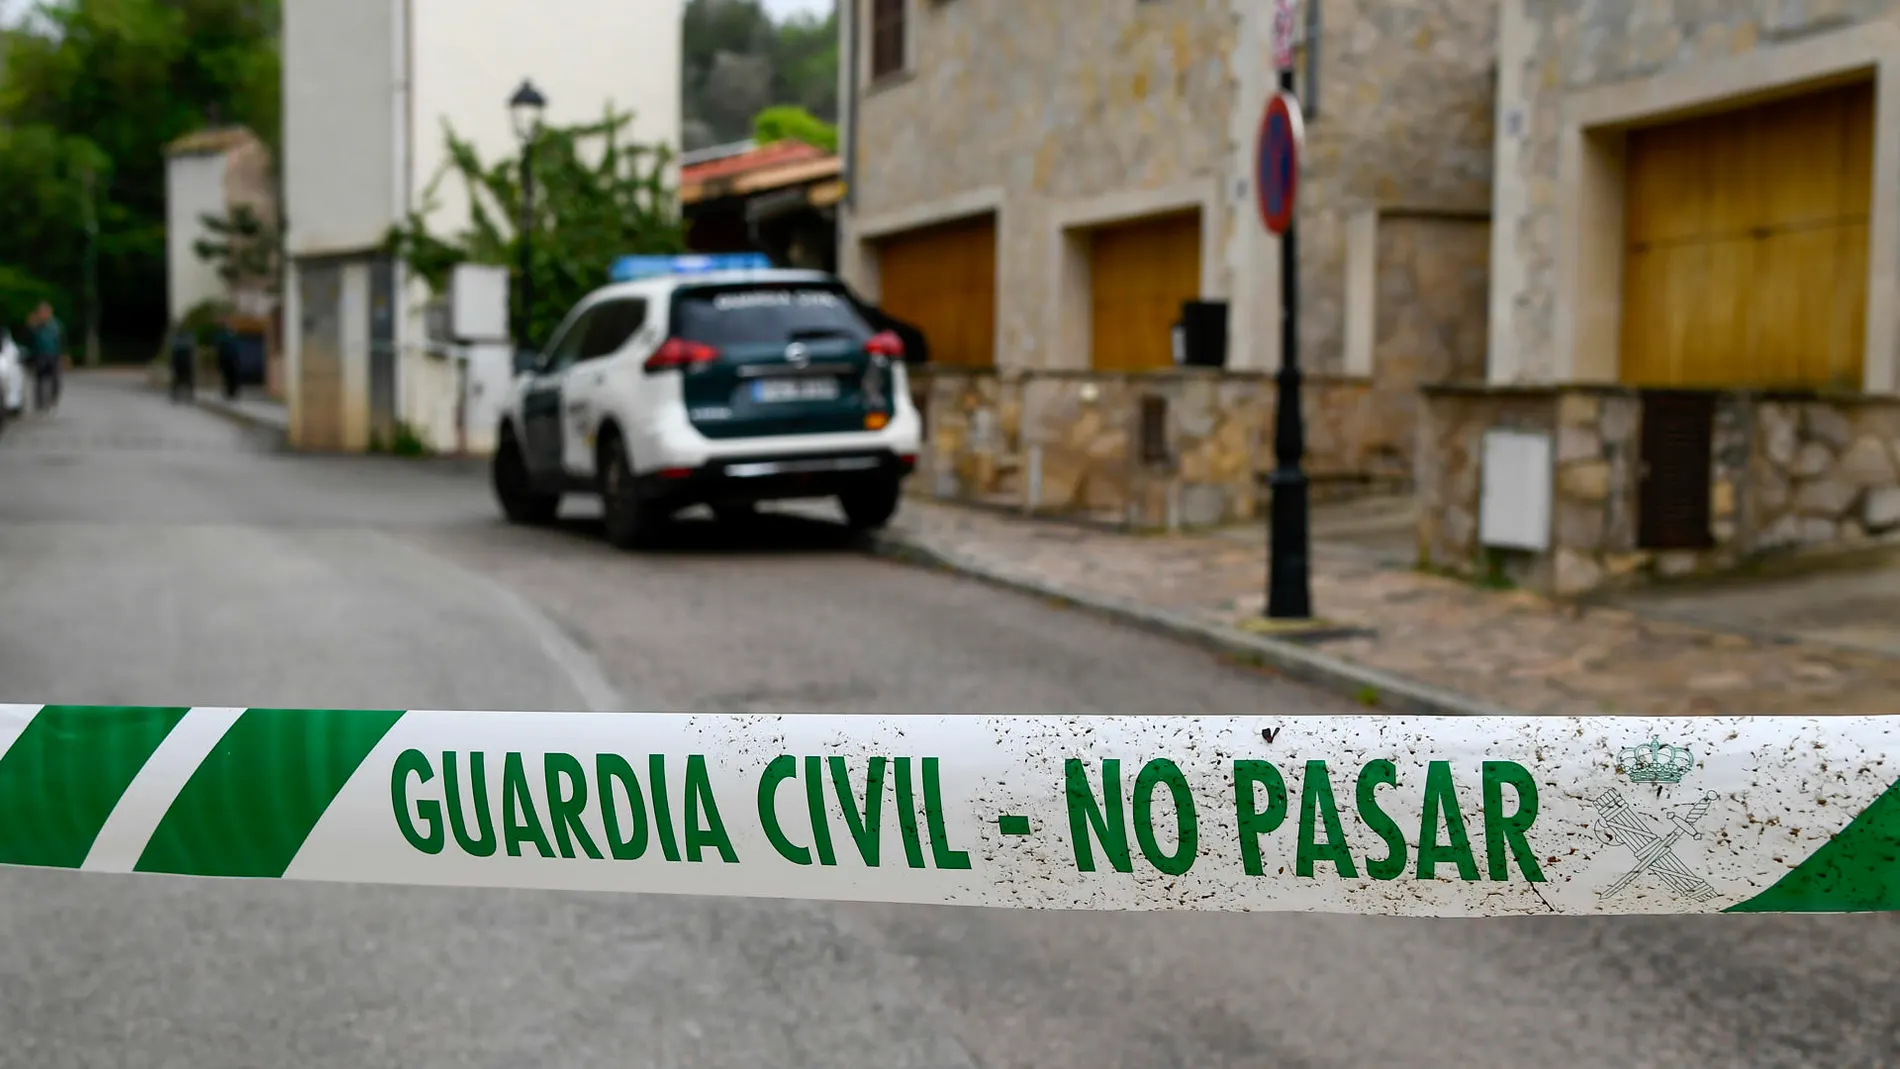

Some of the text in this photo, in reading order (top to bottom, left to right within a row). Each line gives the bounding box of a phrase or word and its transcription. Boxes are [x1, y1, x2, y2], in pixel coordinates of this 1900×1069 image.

[391, 748, 1548, 883] GUARDIA CIVIL - NO PASAR
